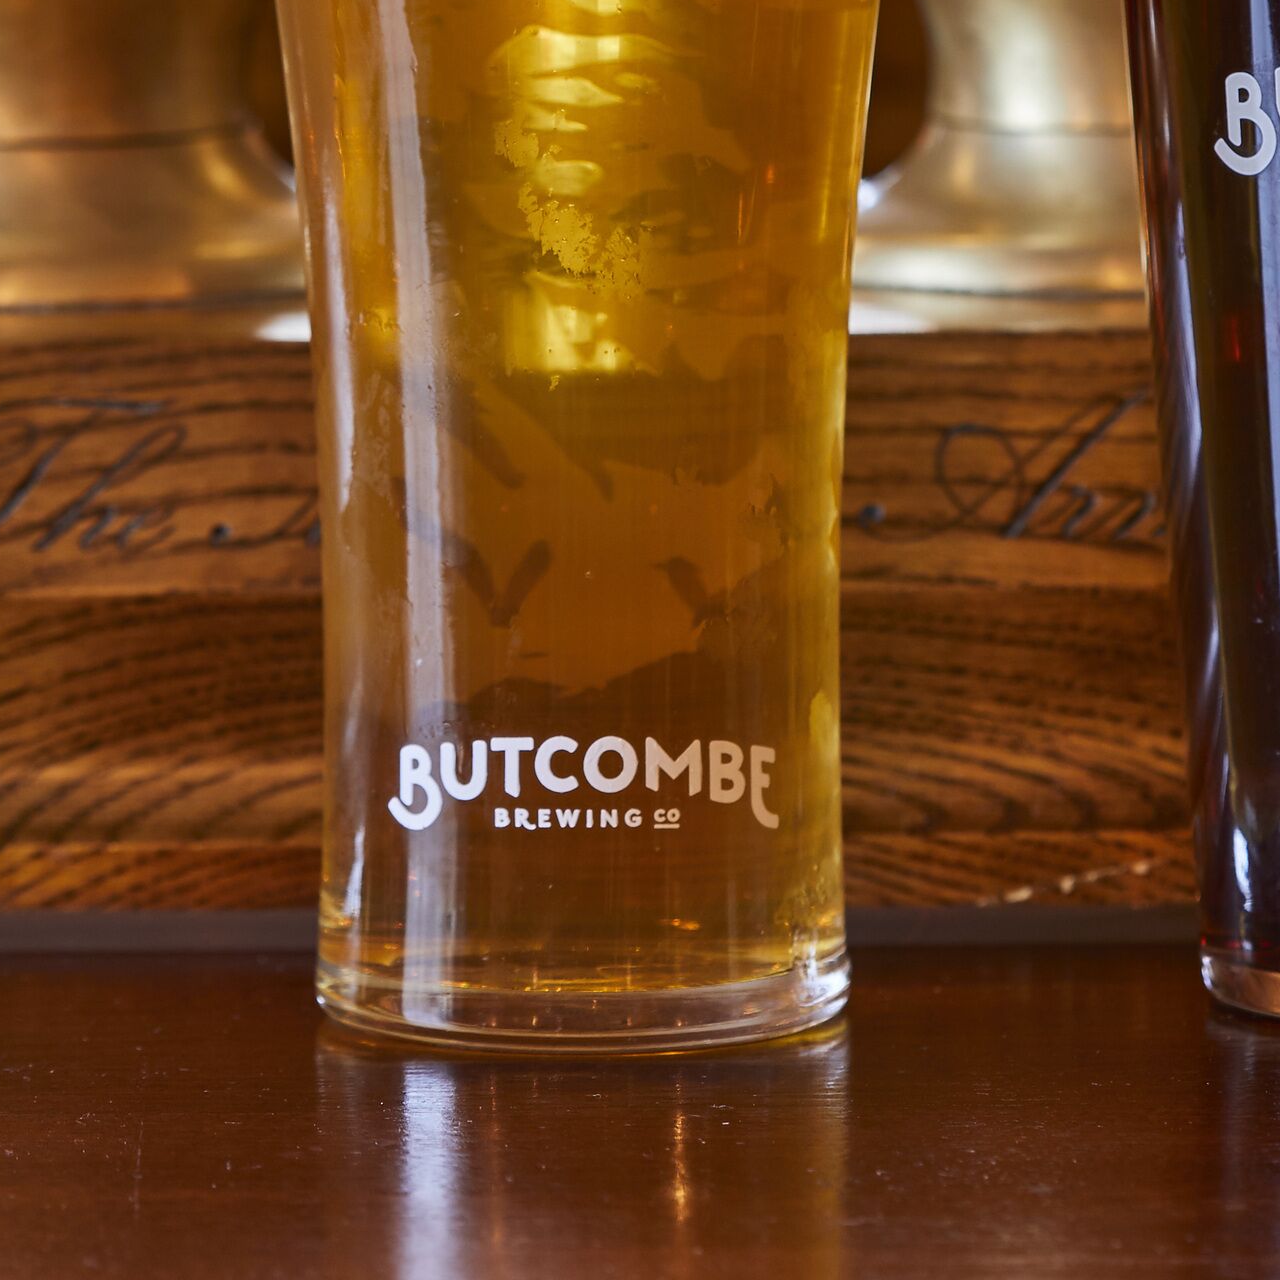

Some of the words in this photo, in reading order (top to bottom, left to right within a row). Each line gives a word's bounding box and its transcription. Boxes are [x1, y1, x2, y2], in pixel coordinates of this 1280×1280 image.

[387, 735, 780, 831] BUTCOMBE
[494, 807, 643, 831] BREWING
[653, 807, 681, 829] CO
